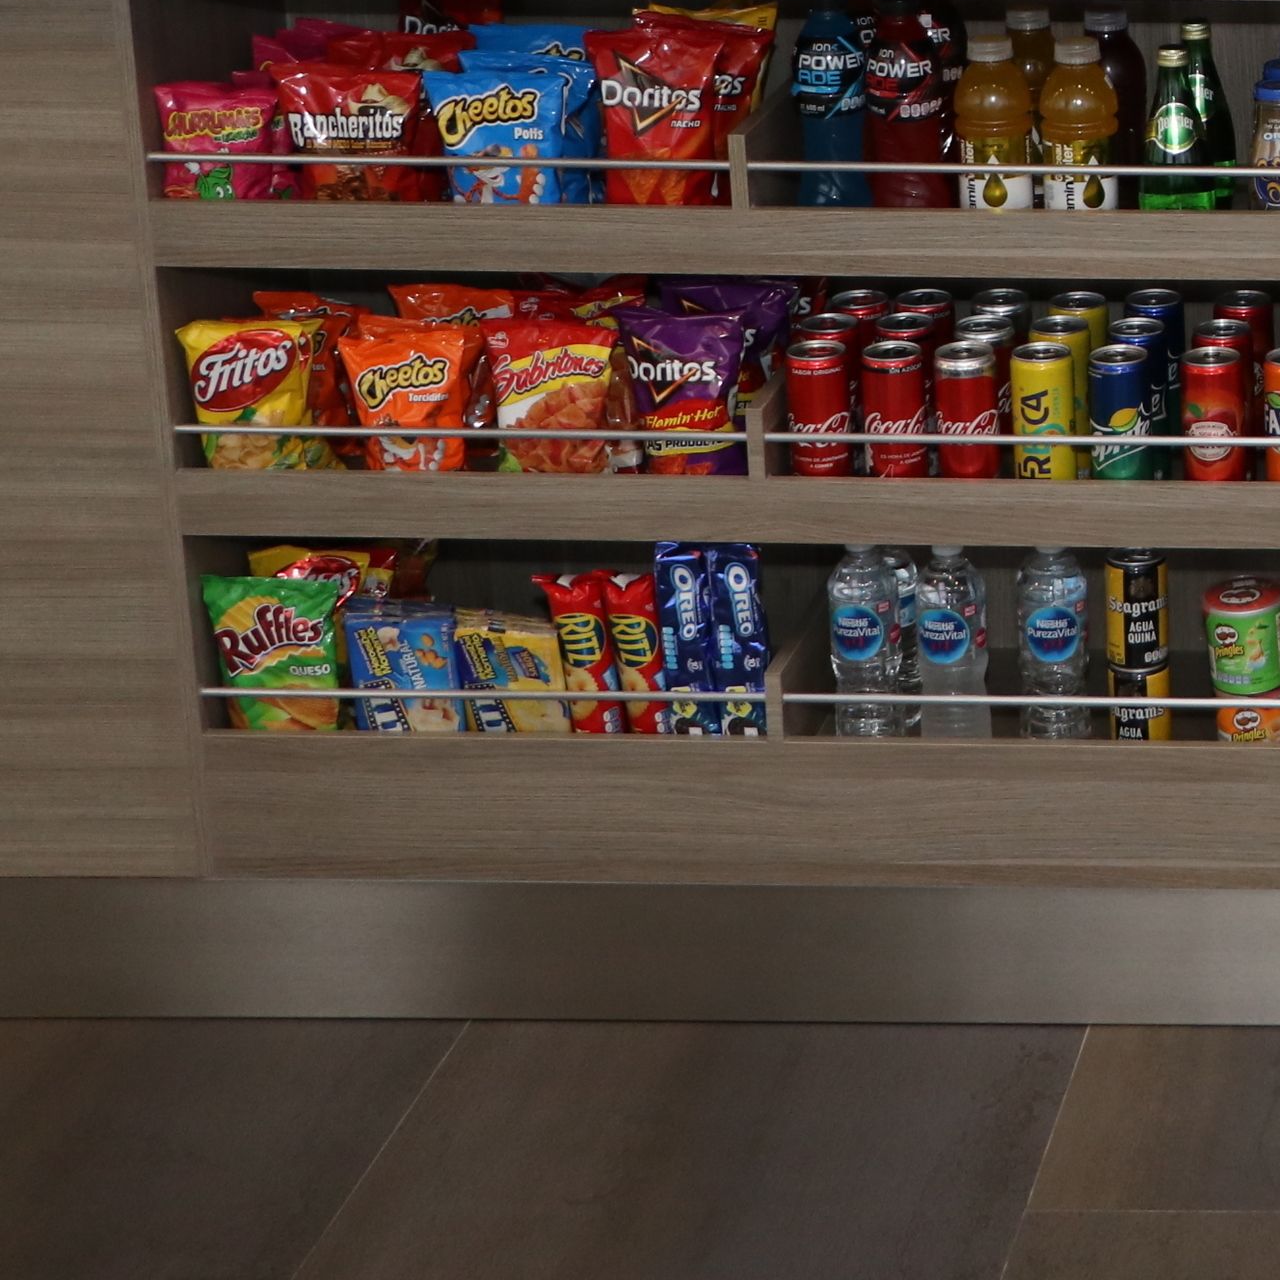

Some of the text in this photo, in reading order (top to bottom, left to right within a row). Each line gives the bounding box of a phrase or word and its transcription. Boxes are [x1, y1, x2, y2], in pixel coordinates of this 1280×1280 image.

[798, 51, 864, 70] POWER
[867, 59, 933, 78] POWER
[798, 70, 841, 85] ADE
[600, 79, 701, 112] Doritos
[288, 107, 403, 147] Rancheritos
[436, 85, 539, 148] Cheetos
[670, 120, 700, 128] NACHO
[194, 338, 293, 402] Fritos
[357, 355, 450, 411] Cheetos
[493, 350, 605, 405] Sabritones
[627, 355, 717, 382] Doritos
[791, 368, 812, 376] SABOR
[672, 565, 697, 639] OREO
[726, 564, 753, 636] OREO
[214, 604, 325, 678] Ruffles
[556, 614, 601, 663] RITZ
[608, 615, 652, 666] RITZ
[1128, 632, 1157, 644] QUINA
[1129, 620, 1155, 632] AGUA
[400, 639, 427, 689] NATURAL
[1215, 644, 1244, 658] Pringles
[289, 663, 331, 677] QUESO
[1119, 726, 1143, 738] AGUA
[1233, 728, 1267, 742] Pringles
